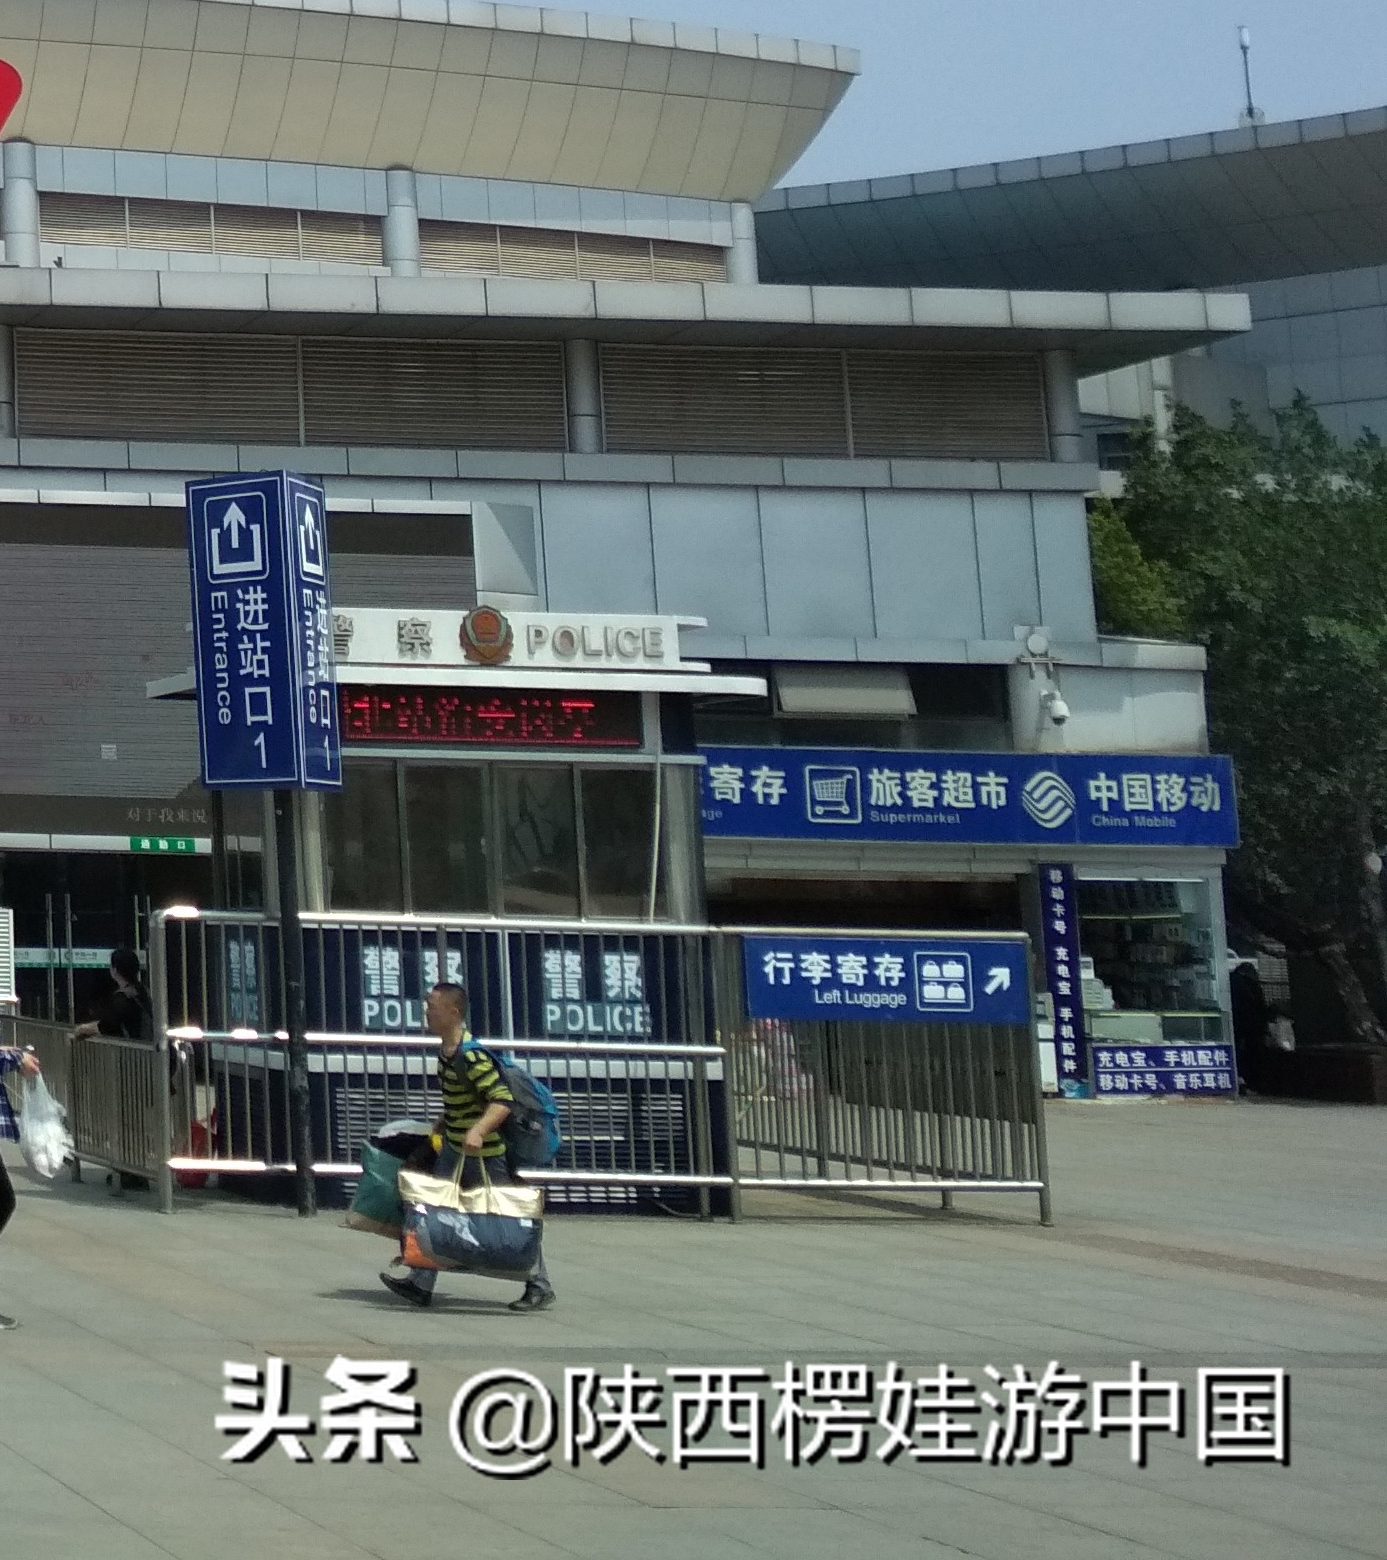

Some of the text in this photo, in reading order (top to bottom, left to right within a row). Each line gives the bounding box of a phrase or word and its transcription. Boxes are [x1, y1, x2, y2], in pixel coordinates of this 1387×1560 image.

[210, 591, 232, 725] Entrance
[302, 589, 317, 725] Entrance
[526, 623, 665, 658] POLICE
[700, 765, 788, 805] 寄存
[867, 768, 1009, 810] 旅客超市
[1088, 772, 1222, 813] 中国移动
[870, 810, 962, 825] Supermarket
[1092, 814, 1177, 828] China Mobile
[544, 948, 643, 1000] 警察
[763, 950, 907, 987] 行李寄存
[1049, 868, 1078, 1074] 移动卡号 充电宝 手机配件
[363, 998, 429, 1029] POLI
[813, 989, 908, 1009] Left Luggage
[546, 1004, 652, 1033] POLICE
